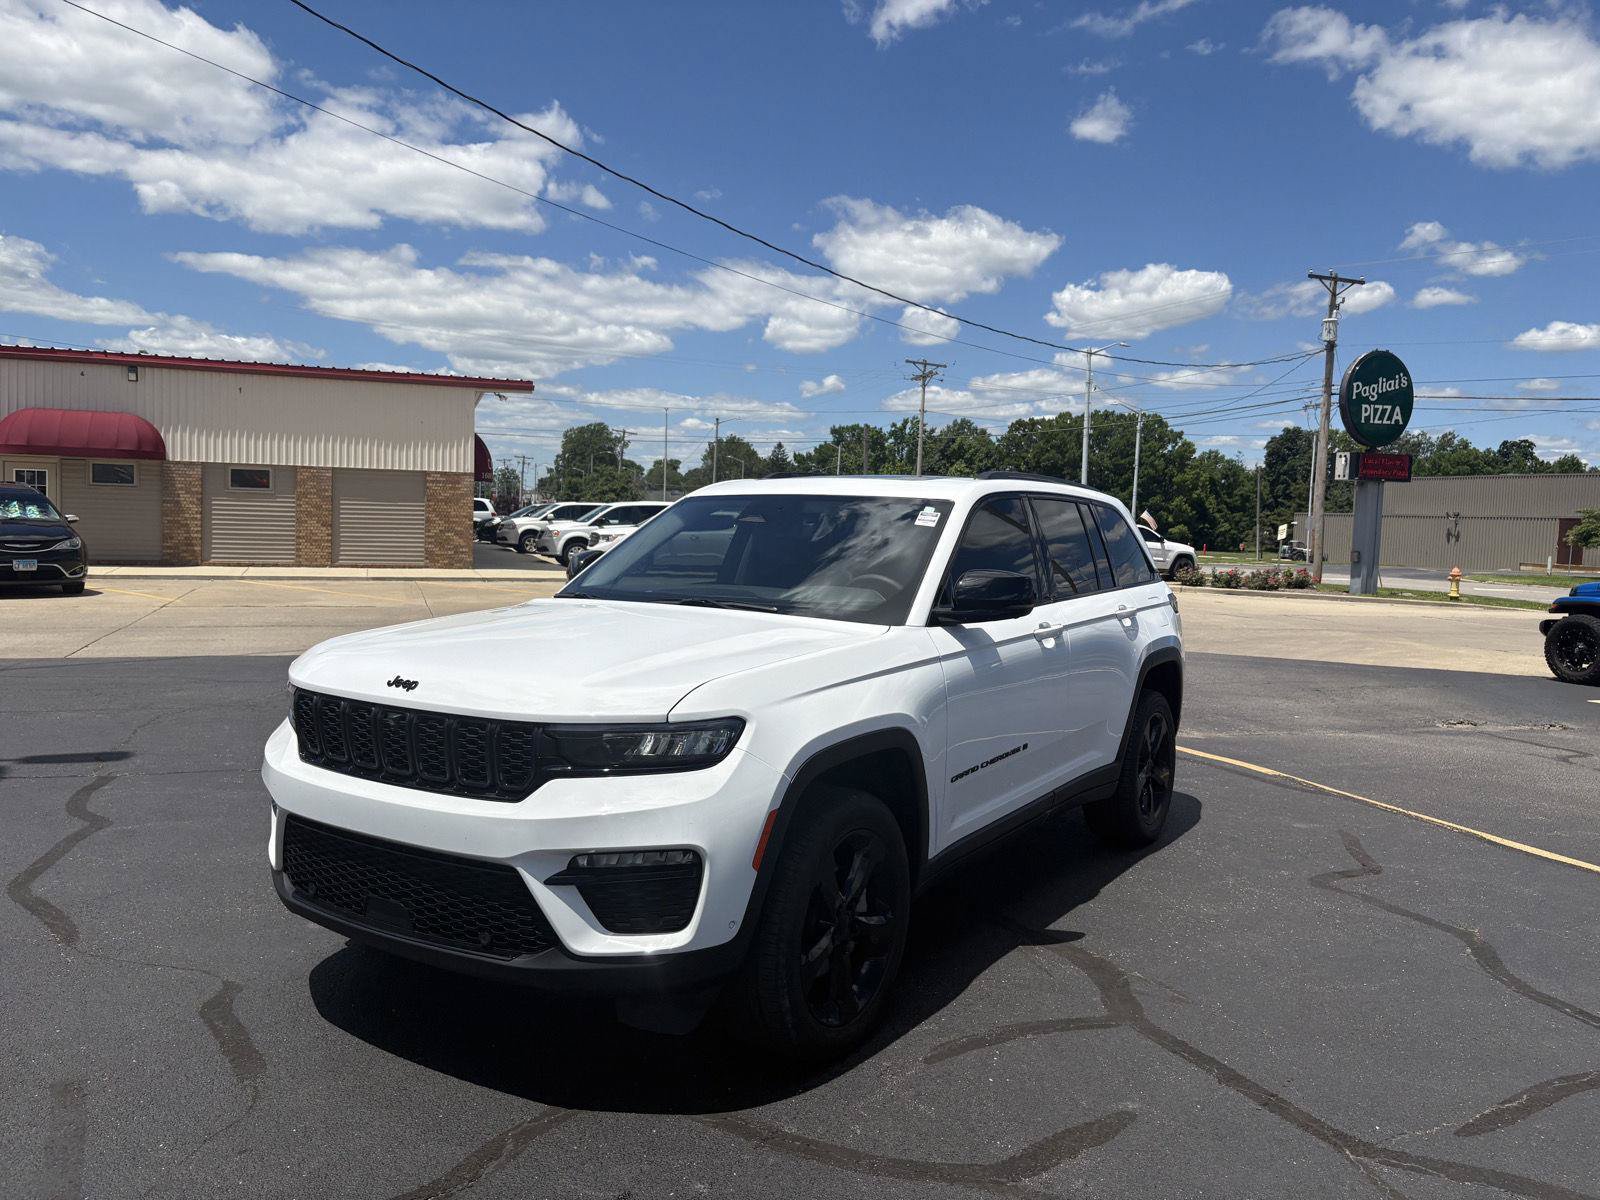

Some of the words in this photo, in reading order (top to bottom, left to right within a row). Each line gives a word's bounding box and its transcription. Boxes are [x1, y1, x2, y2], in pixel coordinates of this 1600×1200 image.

[1352, 372, 1408, 401] Pagliai's
[1361, 404, 1403, 425] PIZZA
[387, 675, 419, 692] Jeep
[951, 765, 979, 783] GRAND
[980, 746, 1022, 769] CHEROKEE
